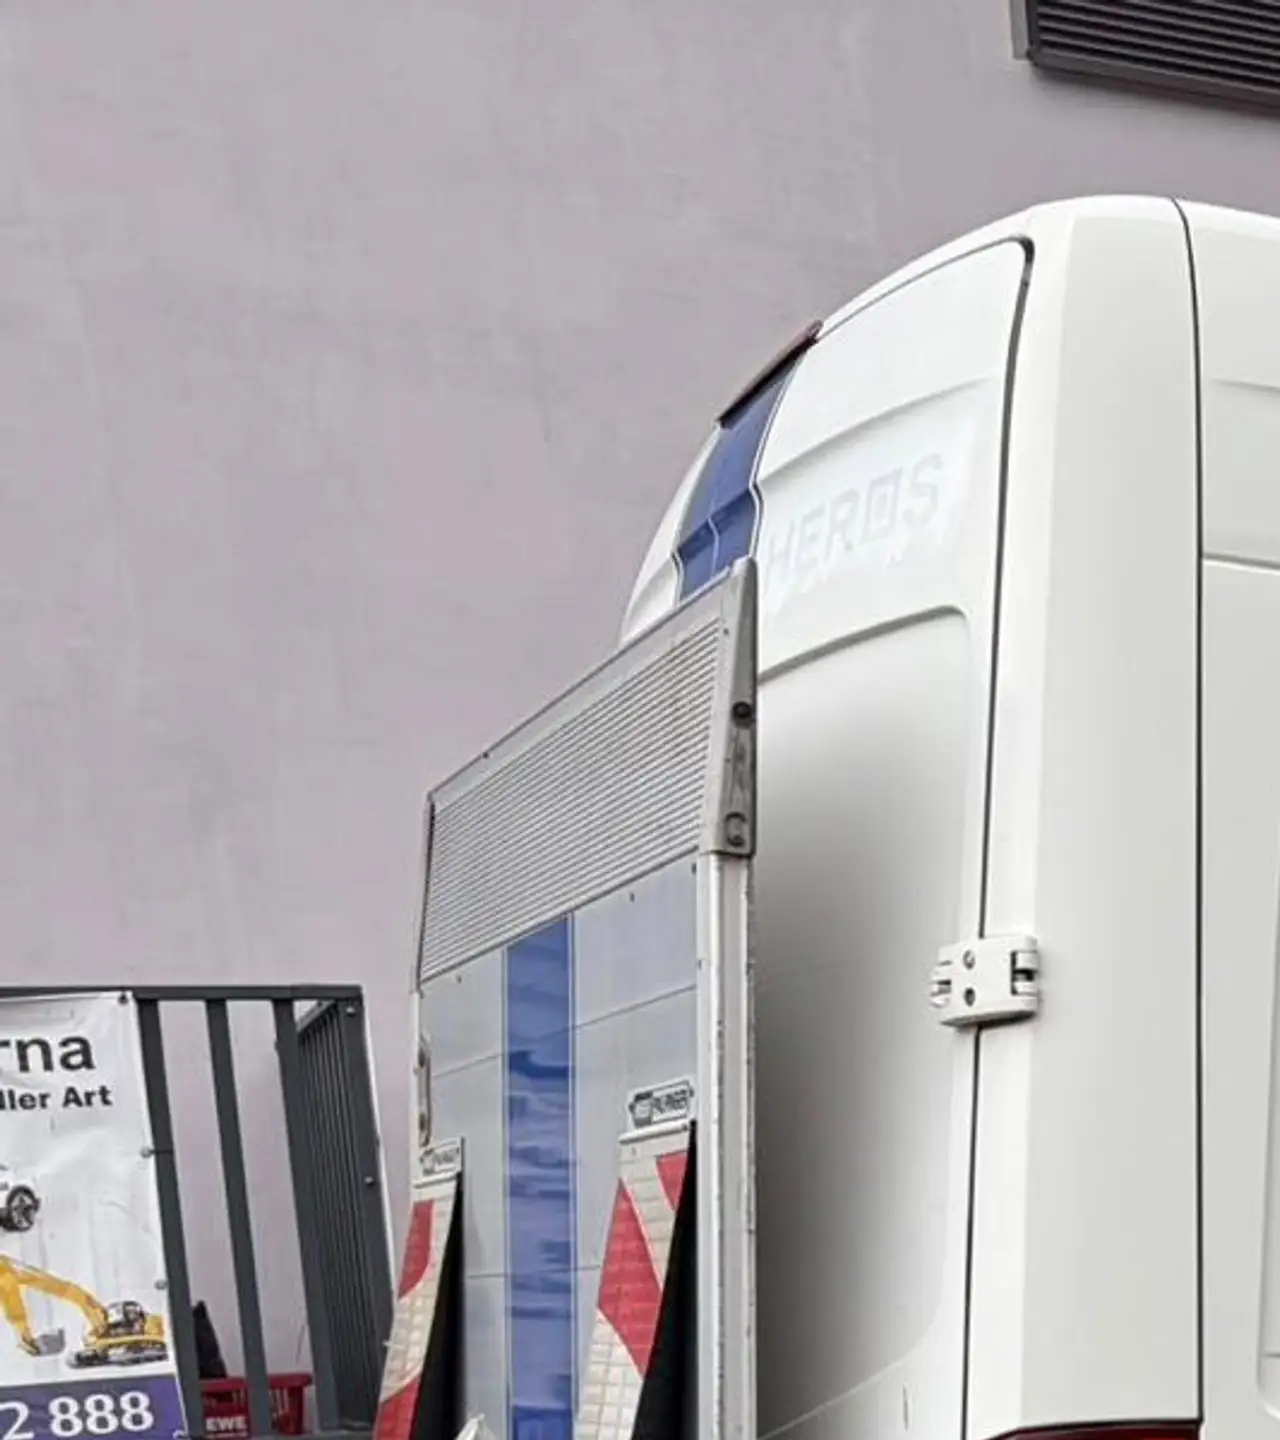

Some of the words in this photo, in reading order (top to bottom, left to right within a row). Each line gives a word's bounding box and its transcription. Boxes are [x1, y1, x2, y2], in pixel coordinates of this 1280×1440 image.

[765, 453, 944, 590] HEROS
[62, 1084, 113, 1108] Art
[49, 1390, 154, 1438] 888
